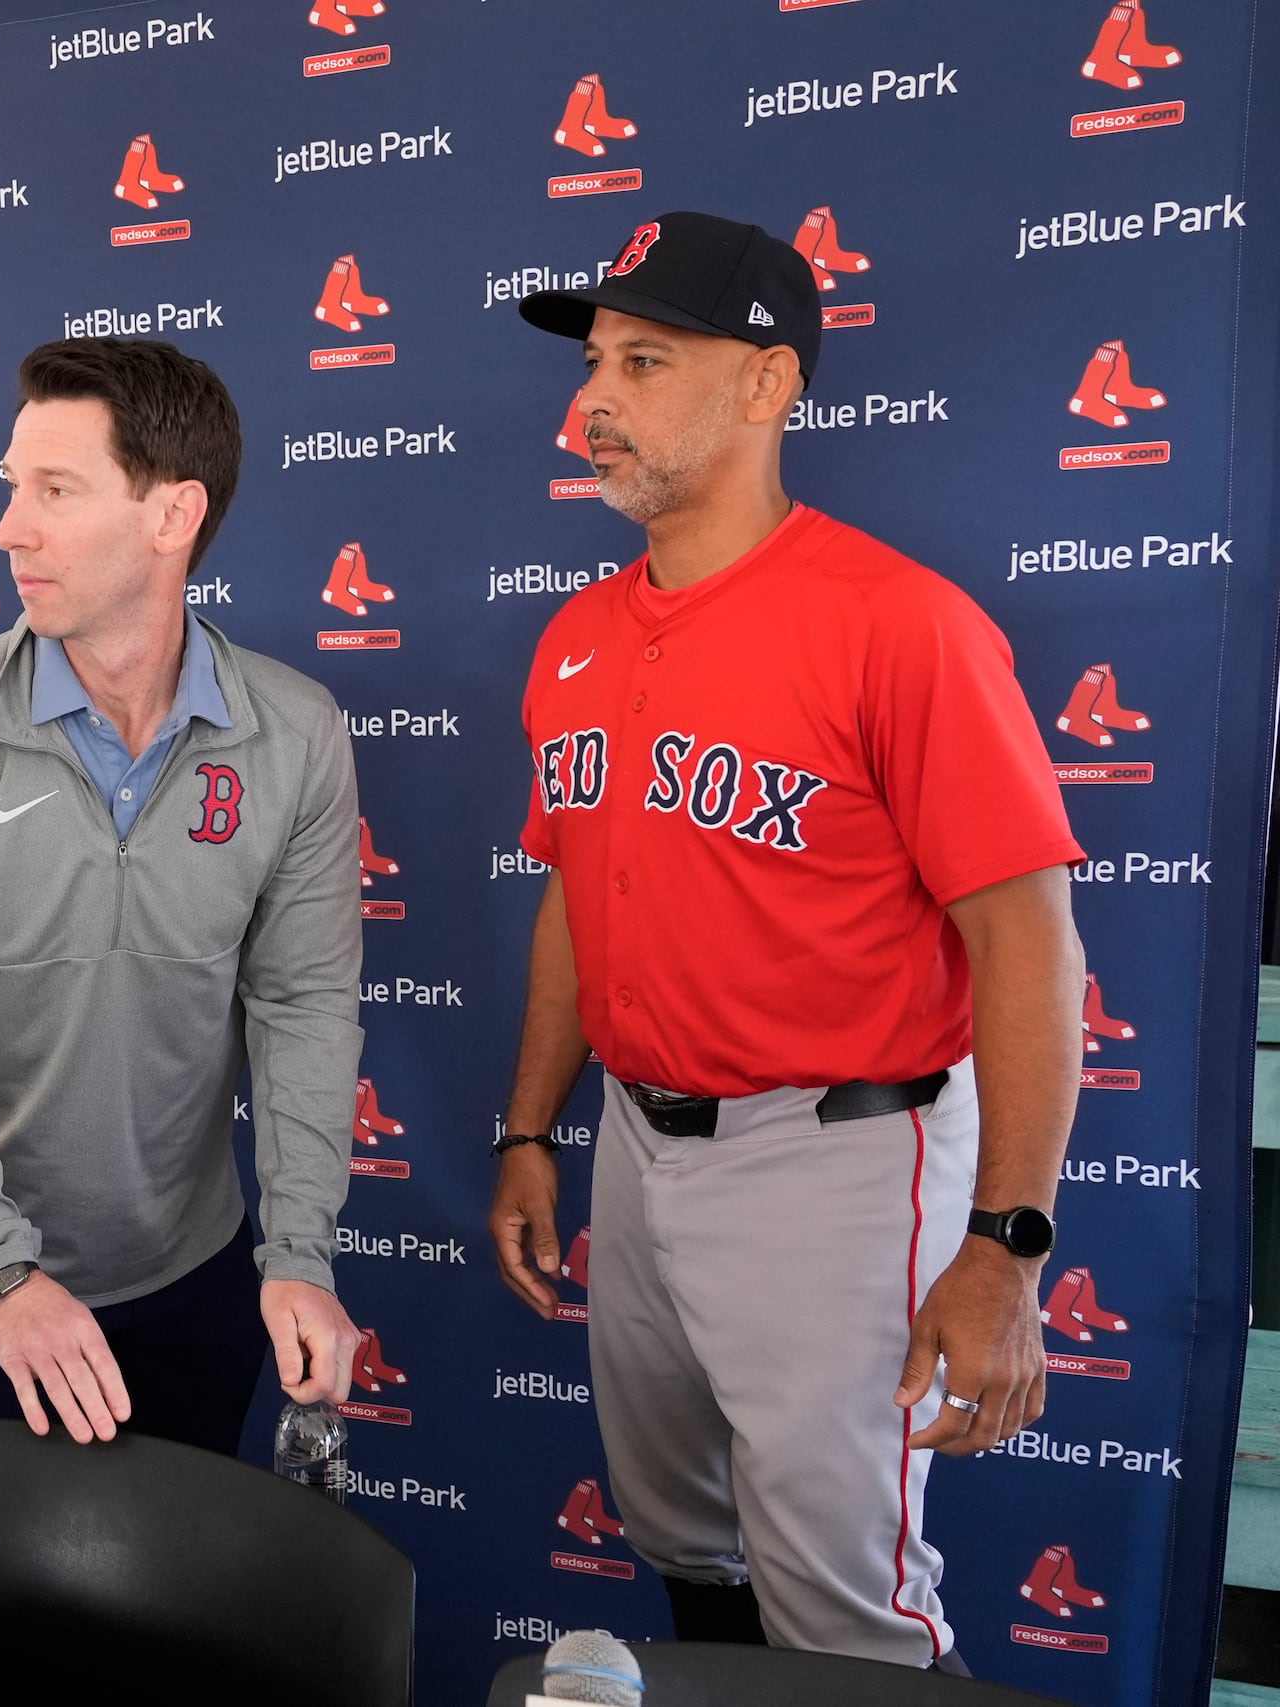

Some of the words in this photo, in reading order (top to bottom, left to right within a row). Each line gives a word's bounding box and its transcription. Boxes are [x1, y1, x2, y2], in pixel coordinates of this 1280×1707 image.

[50, 28, 140, 69] jetBlue
[148, 13, 214, 48] Park
[308, 50, 386, 72] redsox.com
[745, 79, 862, 127] jetBlue
[872, 63, 957, 103] Park
[1076, 106, 1179, 131] redsox.com
[275, 140, 372, 182] jetBlue
[381, 126, 452, 162] Park
[552, 174, 638, 193] redsox.com
[114, 225, 187, 242] redsox.com
[1016, 211, 1143, 259] jetBlue
[1154, 195, 1246, 236] Park
[607, 222, 661, 278] B
[65, 308, 151, 339] jetBlue
[158, 300, 223, 331] Park
[823, 309, 868, 323] x.com
[314, 349, 391, 365] redsox.com
[784, 400, 856, 431] Blue
[866, 391, 948, 425] Park
[283, 431, 378, 469] jetBlue
[386, 425, 456, 456] Park
[1065, 447, 1165, 465] redsox.com
[554, 482, 601, 494] redsox
[1007, 540, 1132, 581] jetBlue
[1143, 533, 1233, 567] Park
[183, 577, 232, 604] ark
[487, 565, 590, 601] jetBlue
[321, 634, 397, 646] redsox.com
[391, 709, 459, 736] Park
[188, 763, 245, 844] B
[532, 727, 609, 818] ED
[645, 731, 828, 852] SOX
[490, 847, 552, 879] jetB
[1125, 853, 1211, 883] Park
[361, 906, 401, 915] x.com
[396, 978, 462, 1006] Park
[1081, 1073, 1135, 1085] ox.com
[351, 1160, 406, 1174] dsox.com
[1116, 1156, 1201, 1189] Park
[335, 1227, 393, 1257] Blue
[401, 1234, 465, 1264] Park
[1046, 1358, 1125, 1374] dsox.com
[494, 1369, 589, 1403] jetBlue
[338, 1405, 408, 1421] redsox.com
[1100, 1440, 1182, 1479] Park
[347, 1471, 396, 1500] Blue
[403, 1478, 466, 1510] Park
